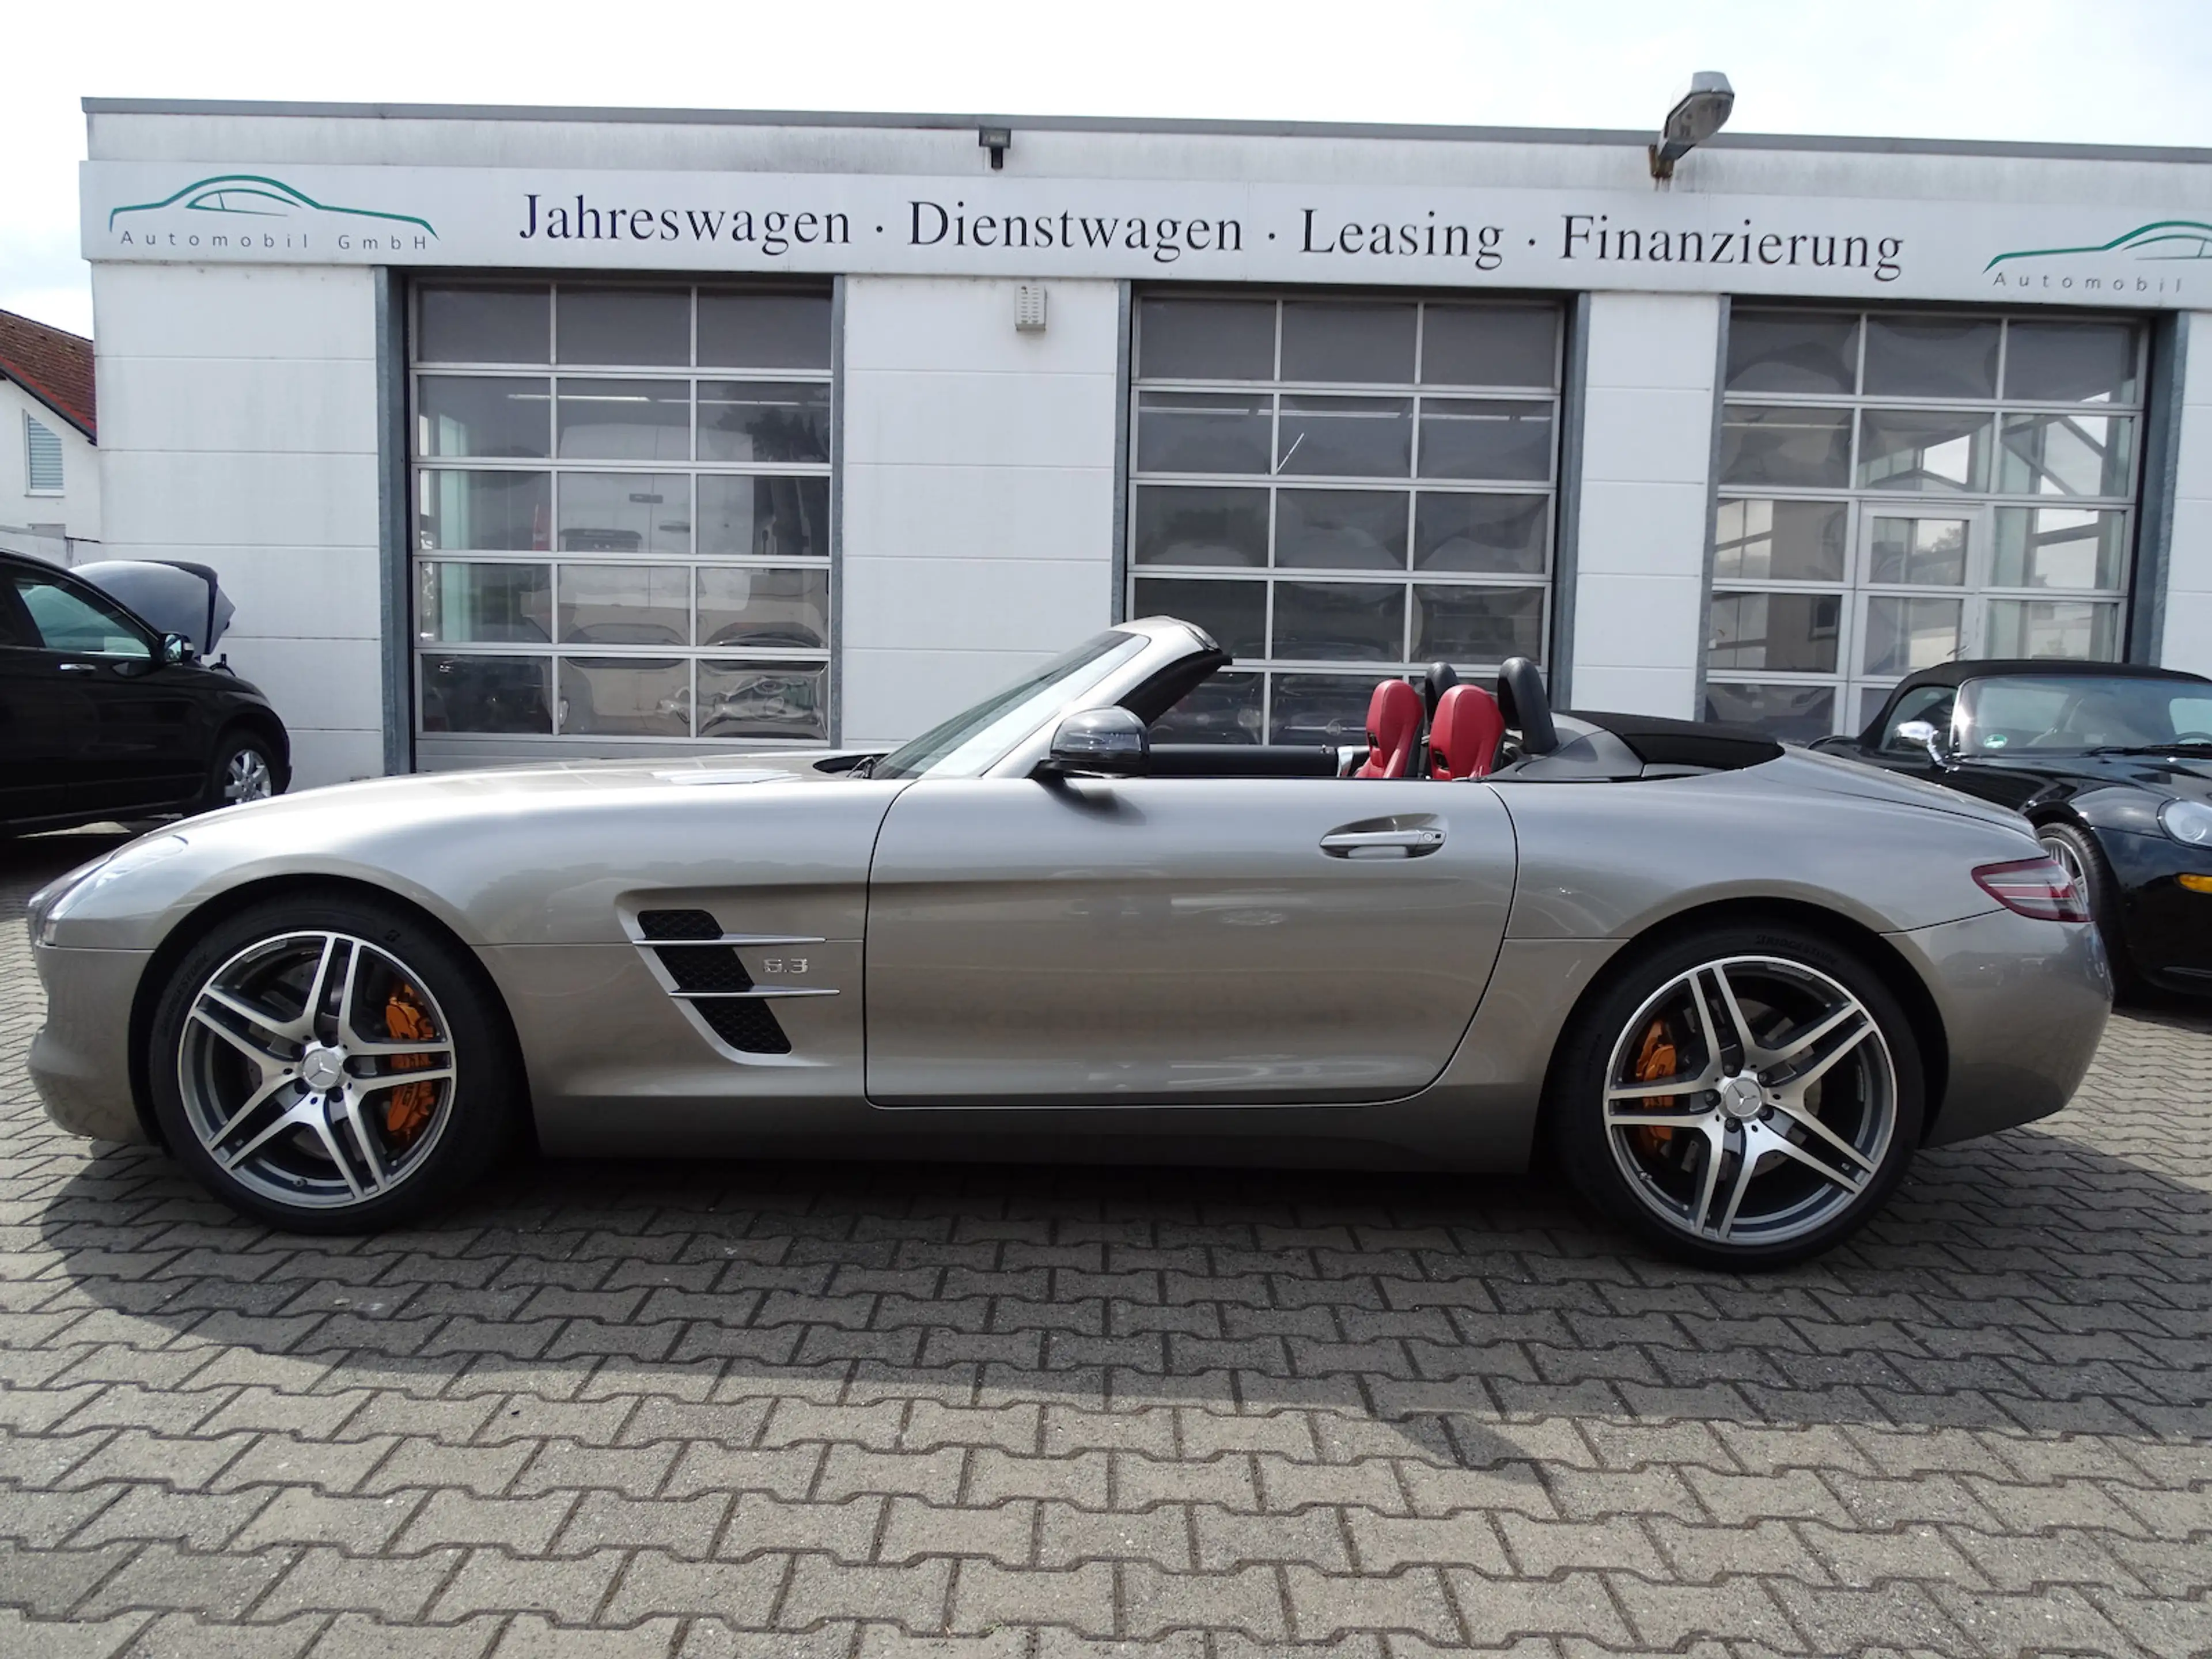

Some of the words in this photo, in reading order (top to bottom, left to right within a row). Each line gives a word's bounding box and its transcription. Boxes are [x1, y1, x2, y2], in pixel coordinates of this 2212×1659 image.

[119, 230, 307, 250] Automobil
[338, 233, 427, 251] GmbH
[519, 194, 852, 256] Jahreswagen
[907, 200, 1243, 263] Dienstwagen
[1299, 208, 1505, 271] Leasing
[1559, 214, 1904, 282] Finanzierung
[1993, 272, 2181, 293] Automobil
[763, 958, 809, 974] 6.3
